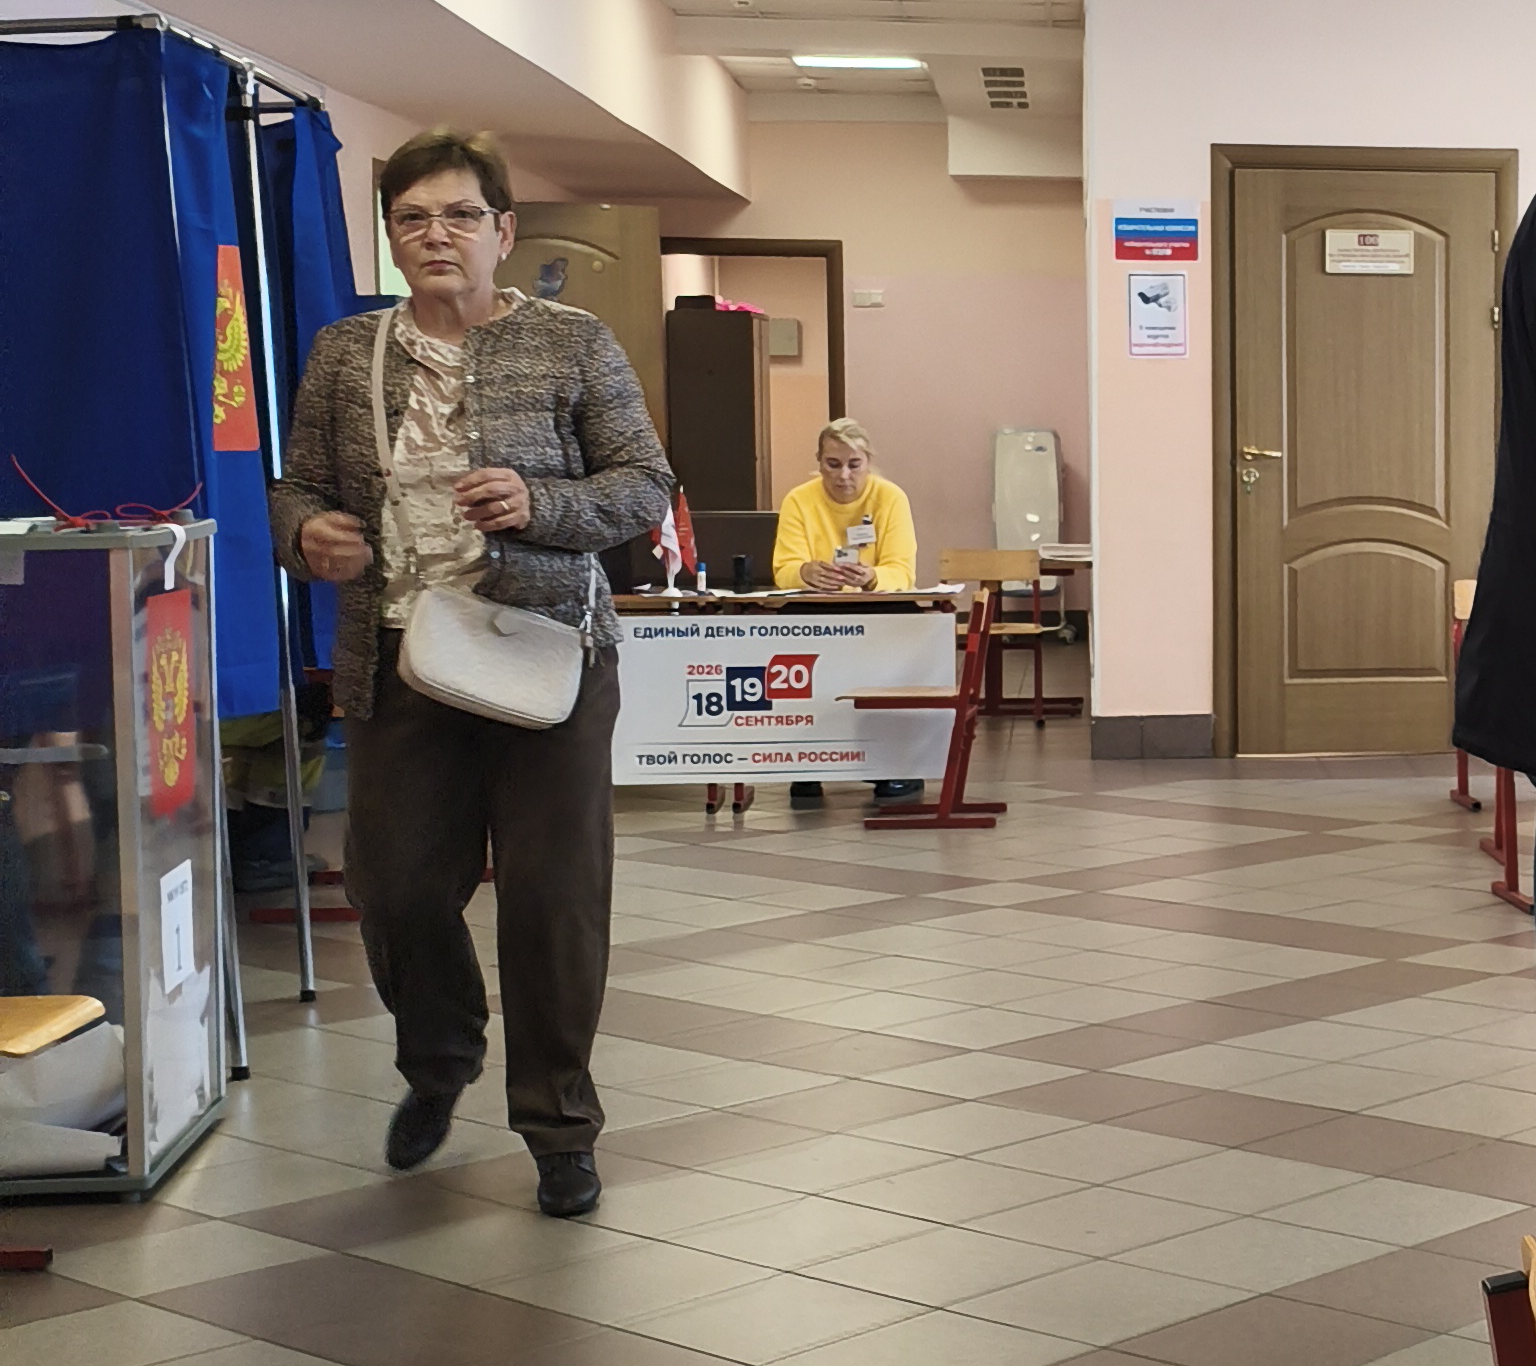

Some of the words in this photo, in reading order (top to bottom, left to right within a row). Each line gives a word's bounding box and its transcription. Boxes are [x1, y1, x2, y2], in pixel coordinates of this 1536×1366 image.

[633, 624, 700, 638] ЕДИНЫЙ
[704, 625, 746, 639] ДЕНЬ
[749, 624, 865, 637] ГОЛОСОВАНИЯ
[686, 664, 723, 676] 2026
[692, 692, 724, 717] 18
[730, 676, 763, 702] 19
[770, 664, 809, 689] 20
[734, 714, 814, 727] СЕНТЯБРЯ
[636, 751, 678, 766] ТВОЙ
[681, 752, 734, 765] ГОЛОС
[751, 751, 794, 764] СИЛА
[798, 750, 866, 764] РОССИИ!
